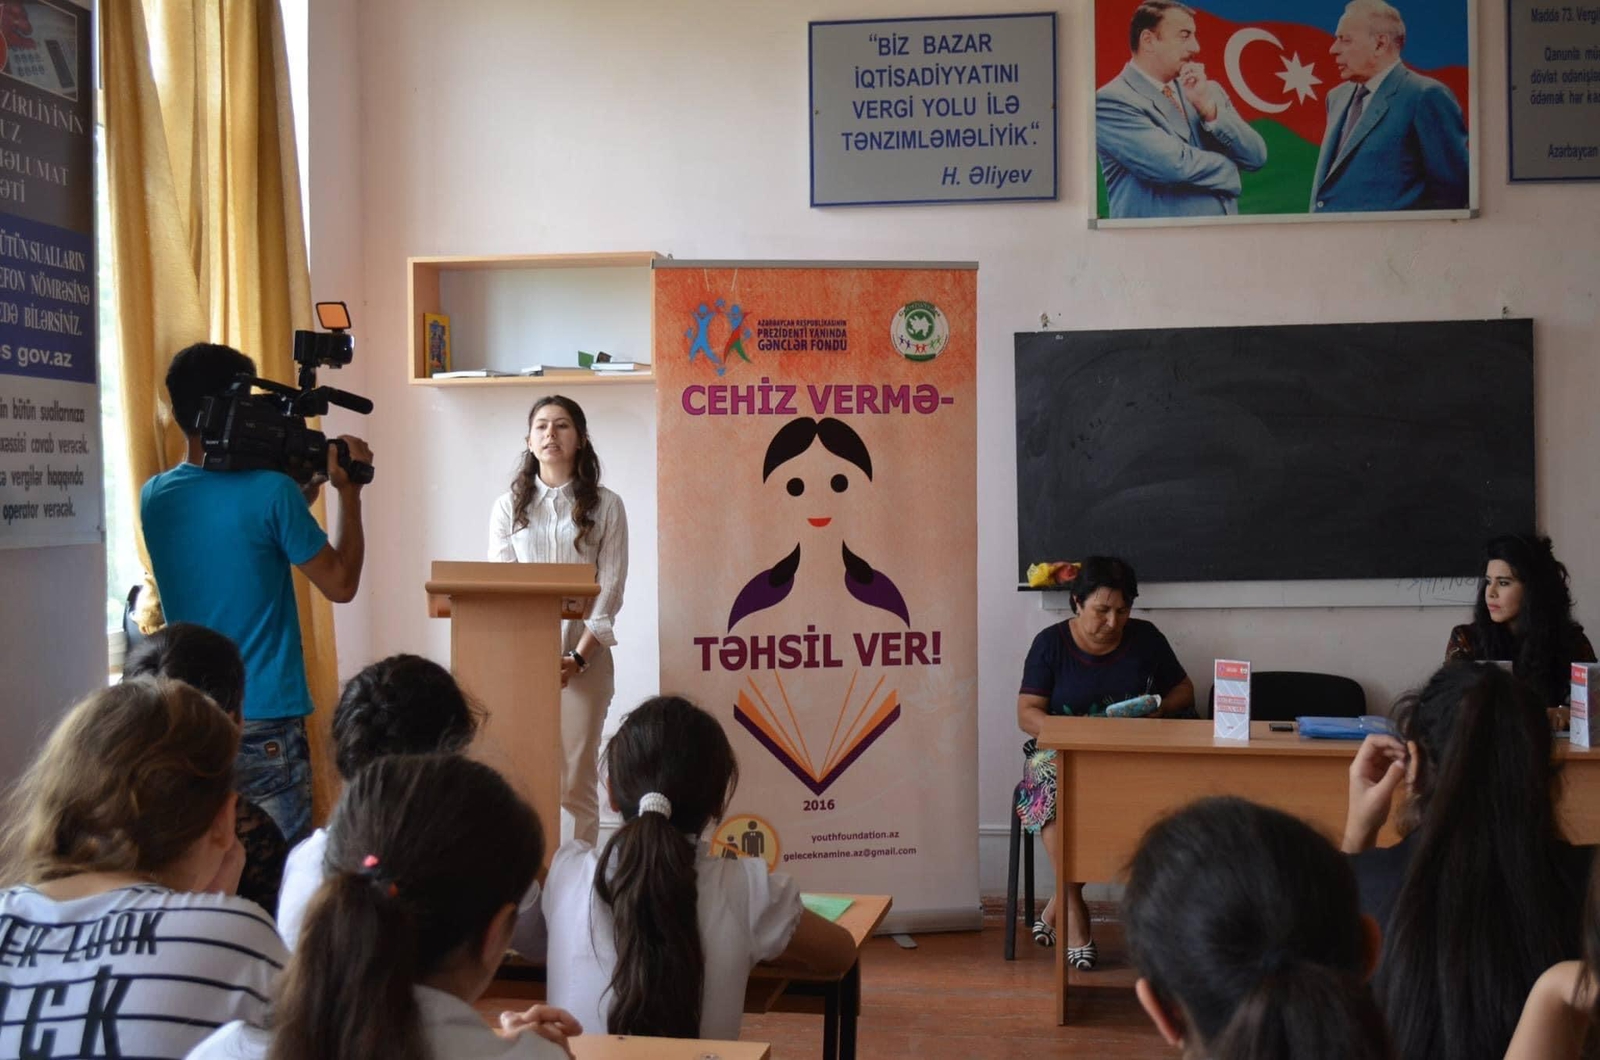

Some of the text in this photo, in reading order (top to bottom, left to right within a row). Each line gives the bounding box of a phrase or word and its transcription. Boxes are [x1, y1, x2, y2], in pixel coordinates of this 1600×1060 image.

[923, 33, 993, 54] BAZAR
[854, 63, 1019, 89] İQTİSADİYYATINI
[852, 92, 1020, 119] VERGİ YOLU İLƏ
[0, 147, 69, 187] ƏLUMAT
[941, 166, 1033, 188] H. Əliyev
[809, 328, 847, 338] YANINDA
[757, 339, 848, 351] GƏNCLƏR FONDU
[18, 347, 73, 367] gov.az
[681, 377, 954, 416] CEHİZ VERMƏ-
[693, 625, 942, 671] TƏHSİL VER!
[803, 799, 836, 811] 2016
[811, 830, 900, 843] youthfoundation.az
[783, 846, 917, 862] geleceknamine.az@gmail.com
